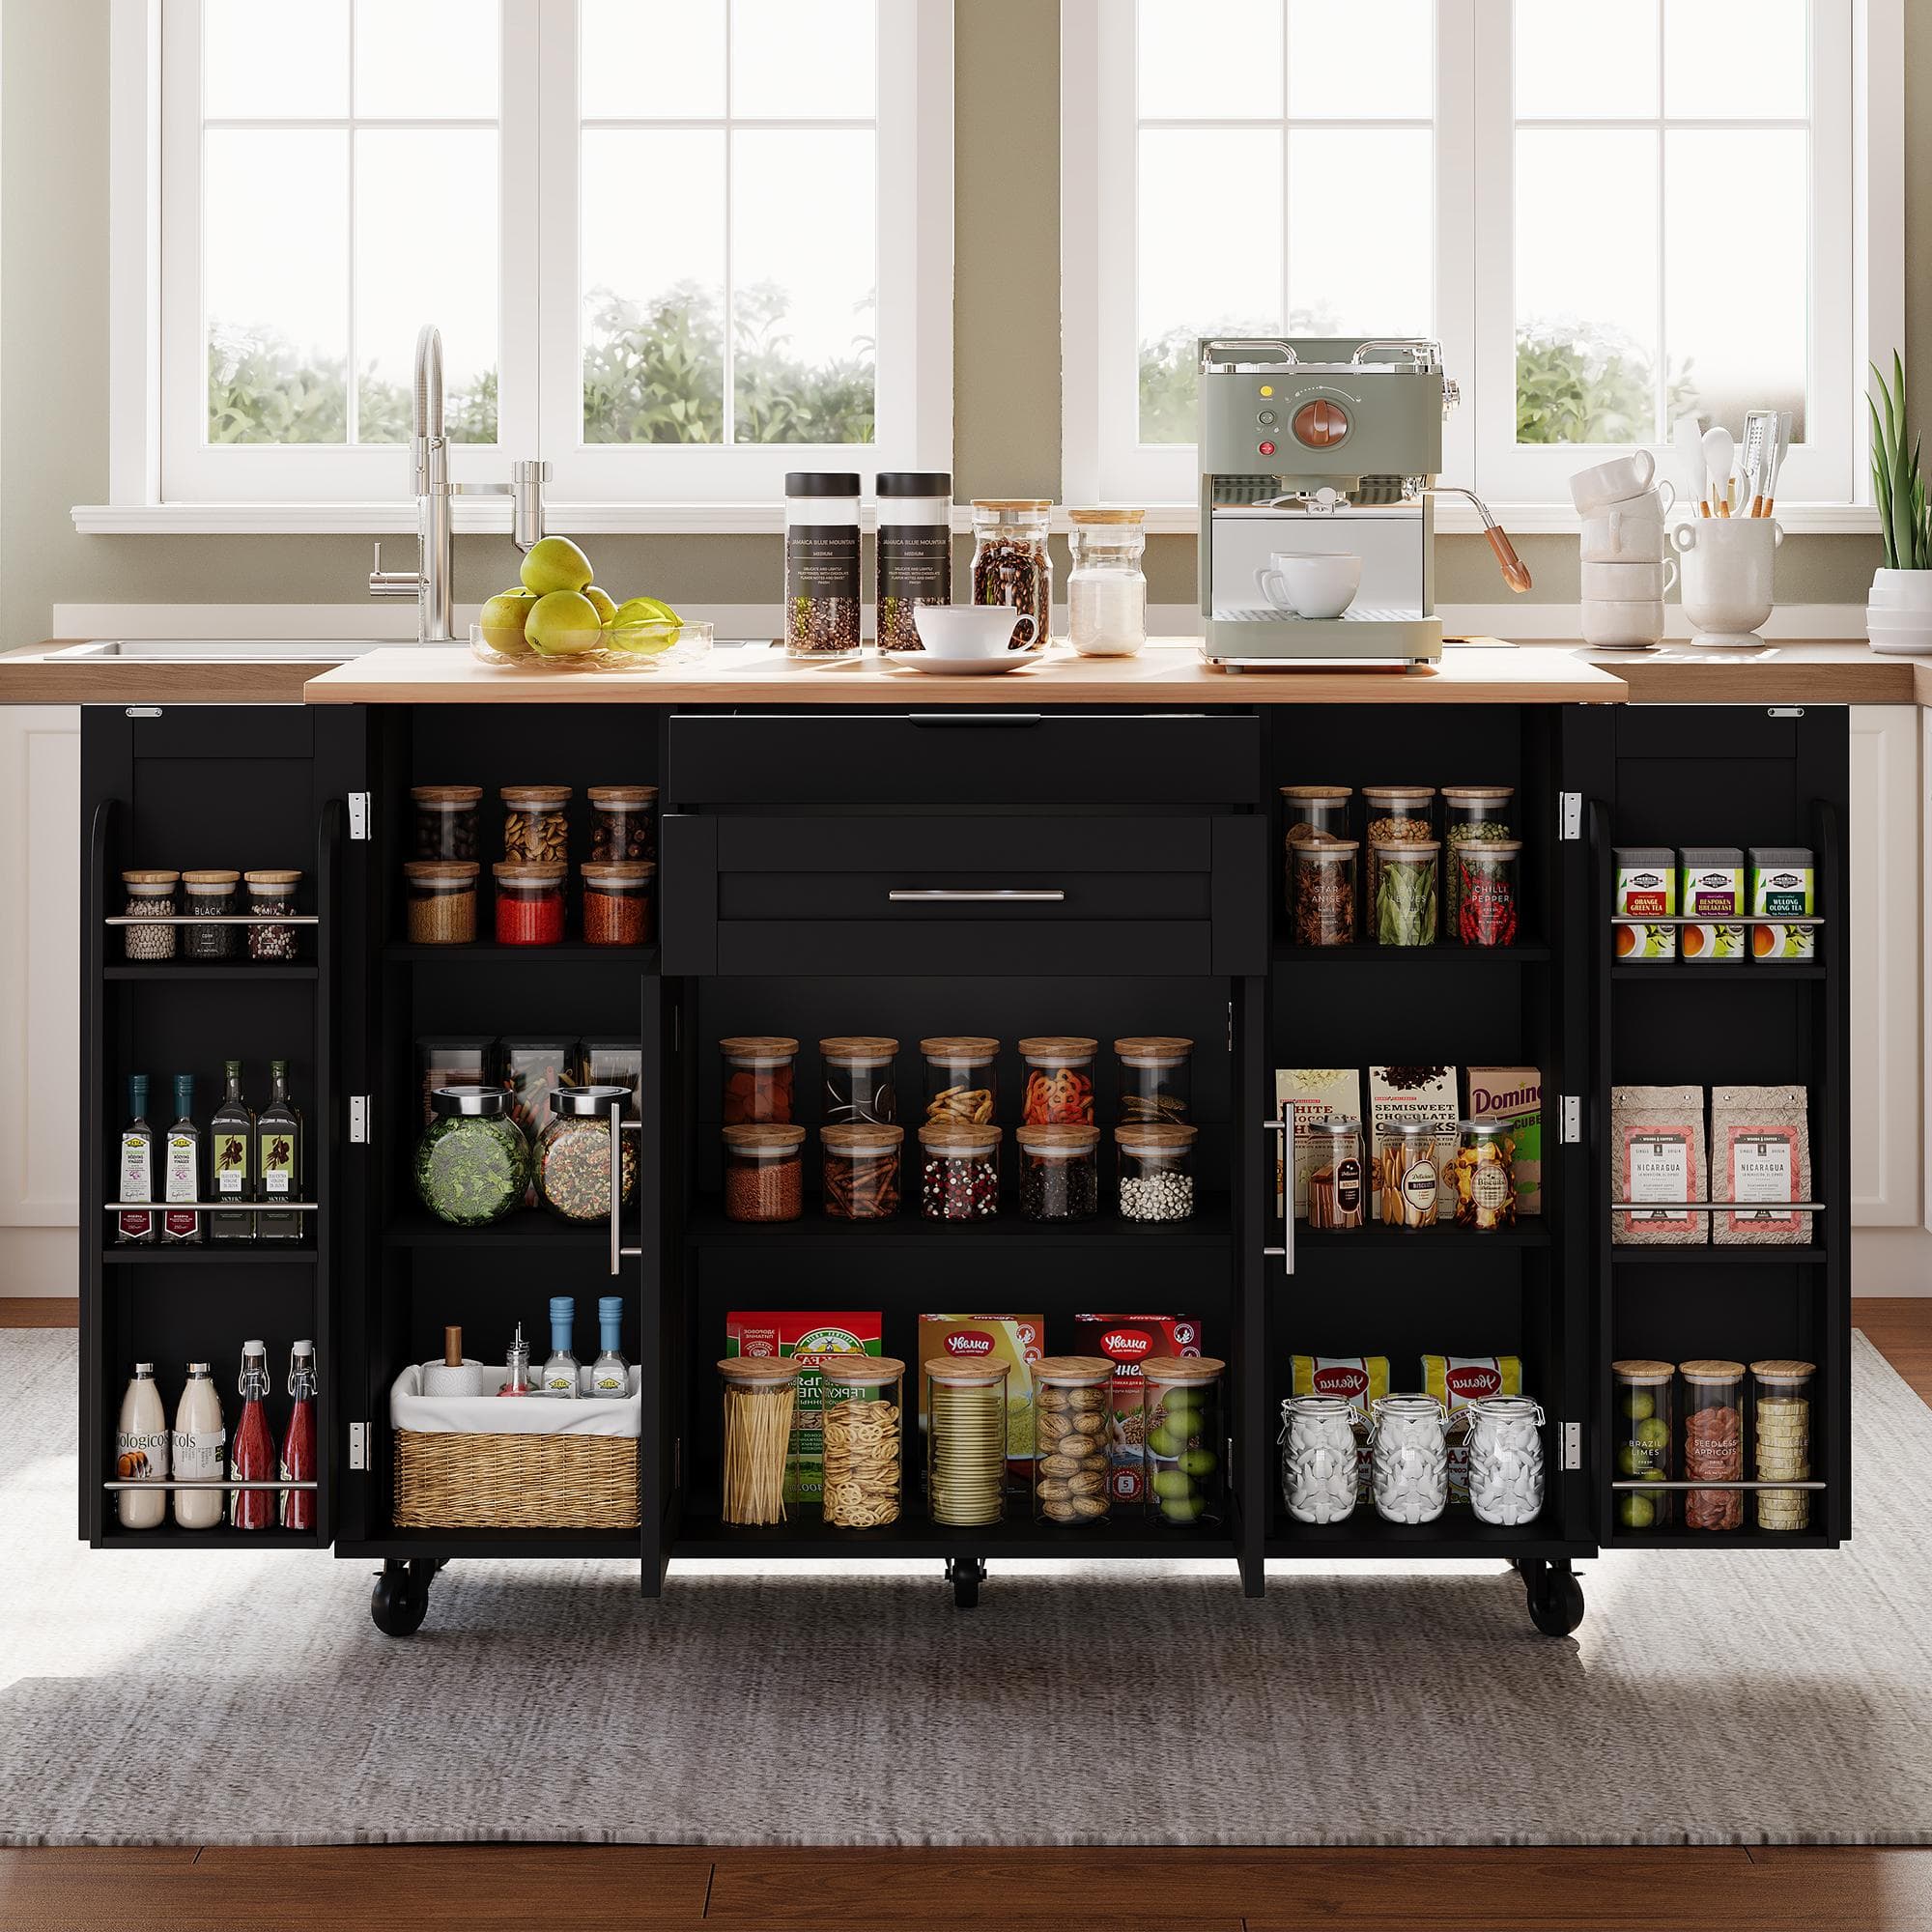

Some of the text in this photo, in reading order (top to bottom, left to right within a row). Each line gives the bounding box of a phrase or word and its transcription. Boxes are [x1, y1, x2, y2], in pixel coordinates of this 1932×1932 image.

[195, 907, 222, 915] BLACK
[1376, 1122, 1455, 1131] CKS
[948, 1336, 989, 1351] Увелка
[1105, 1335, 1147, 1350] Увелка
